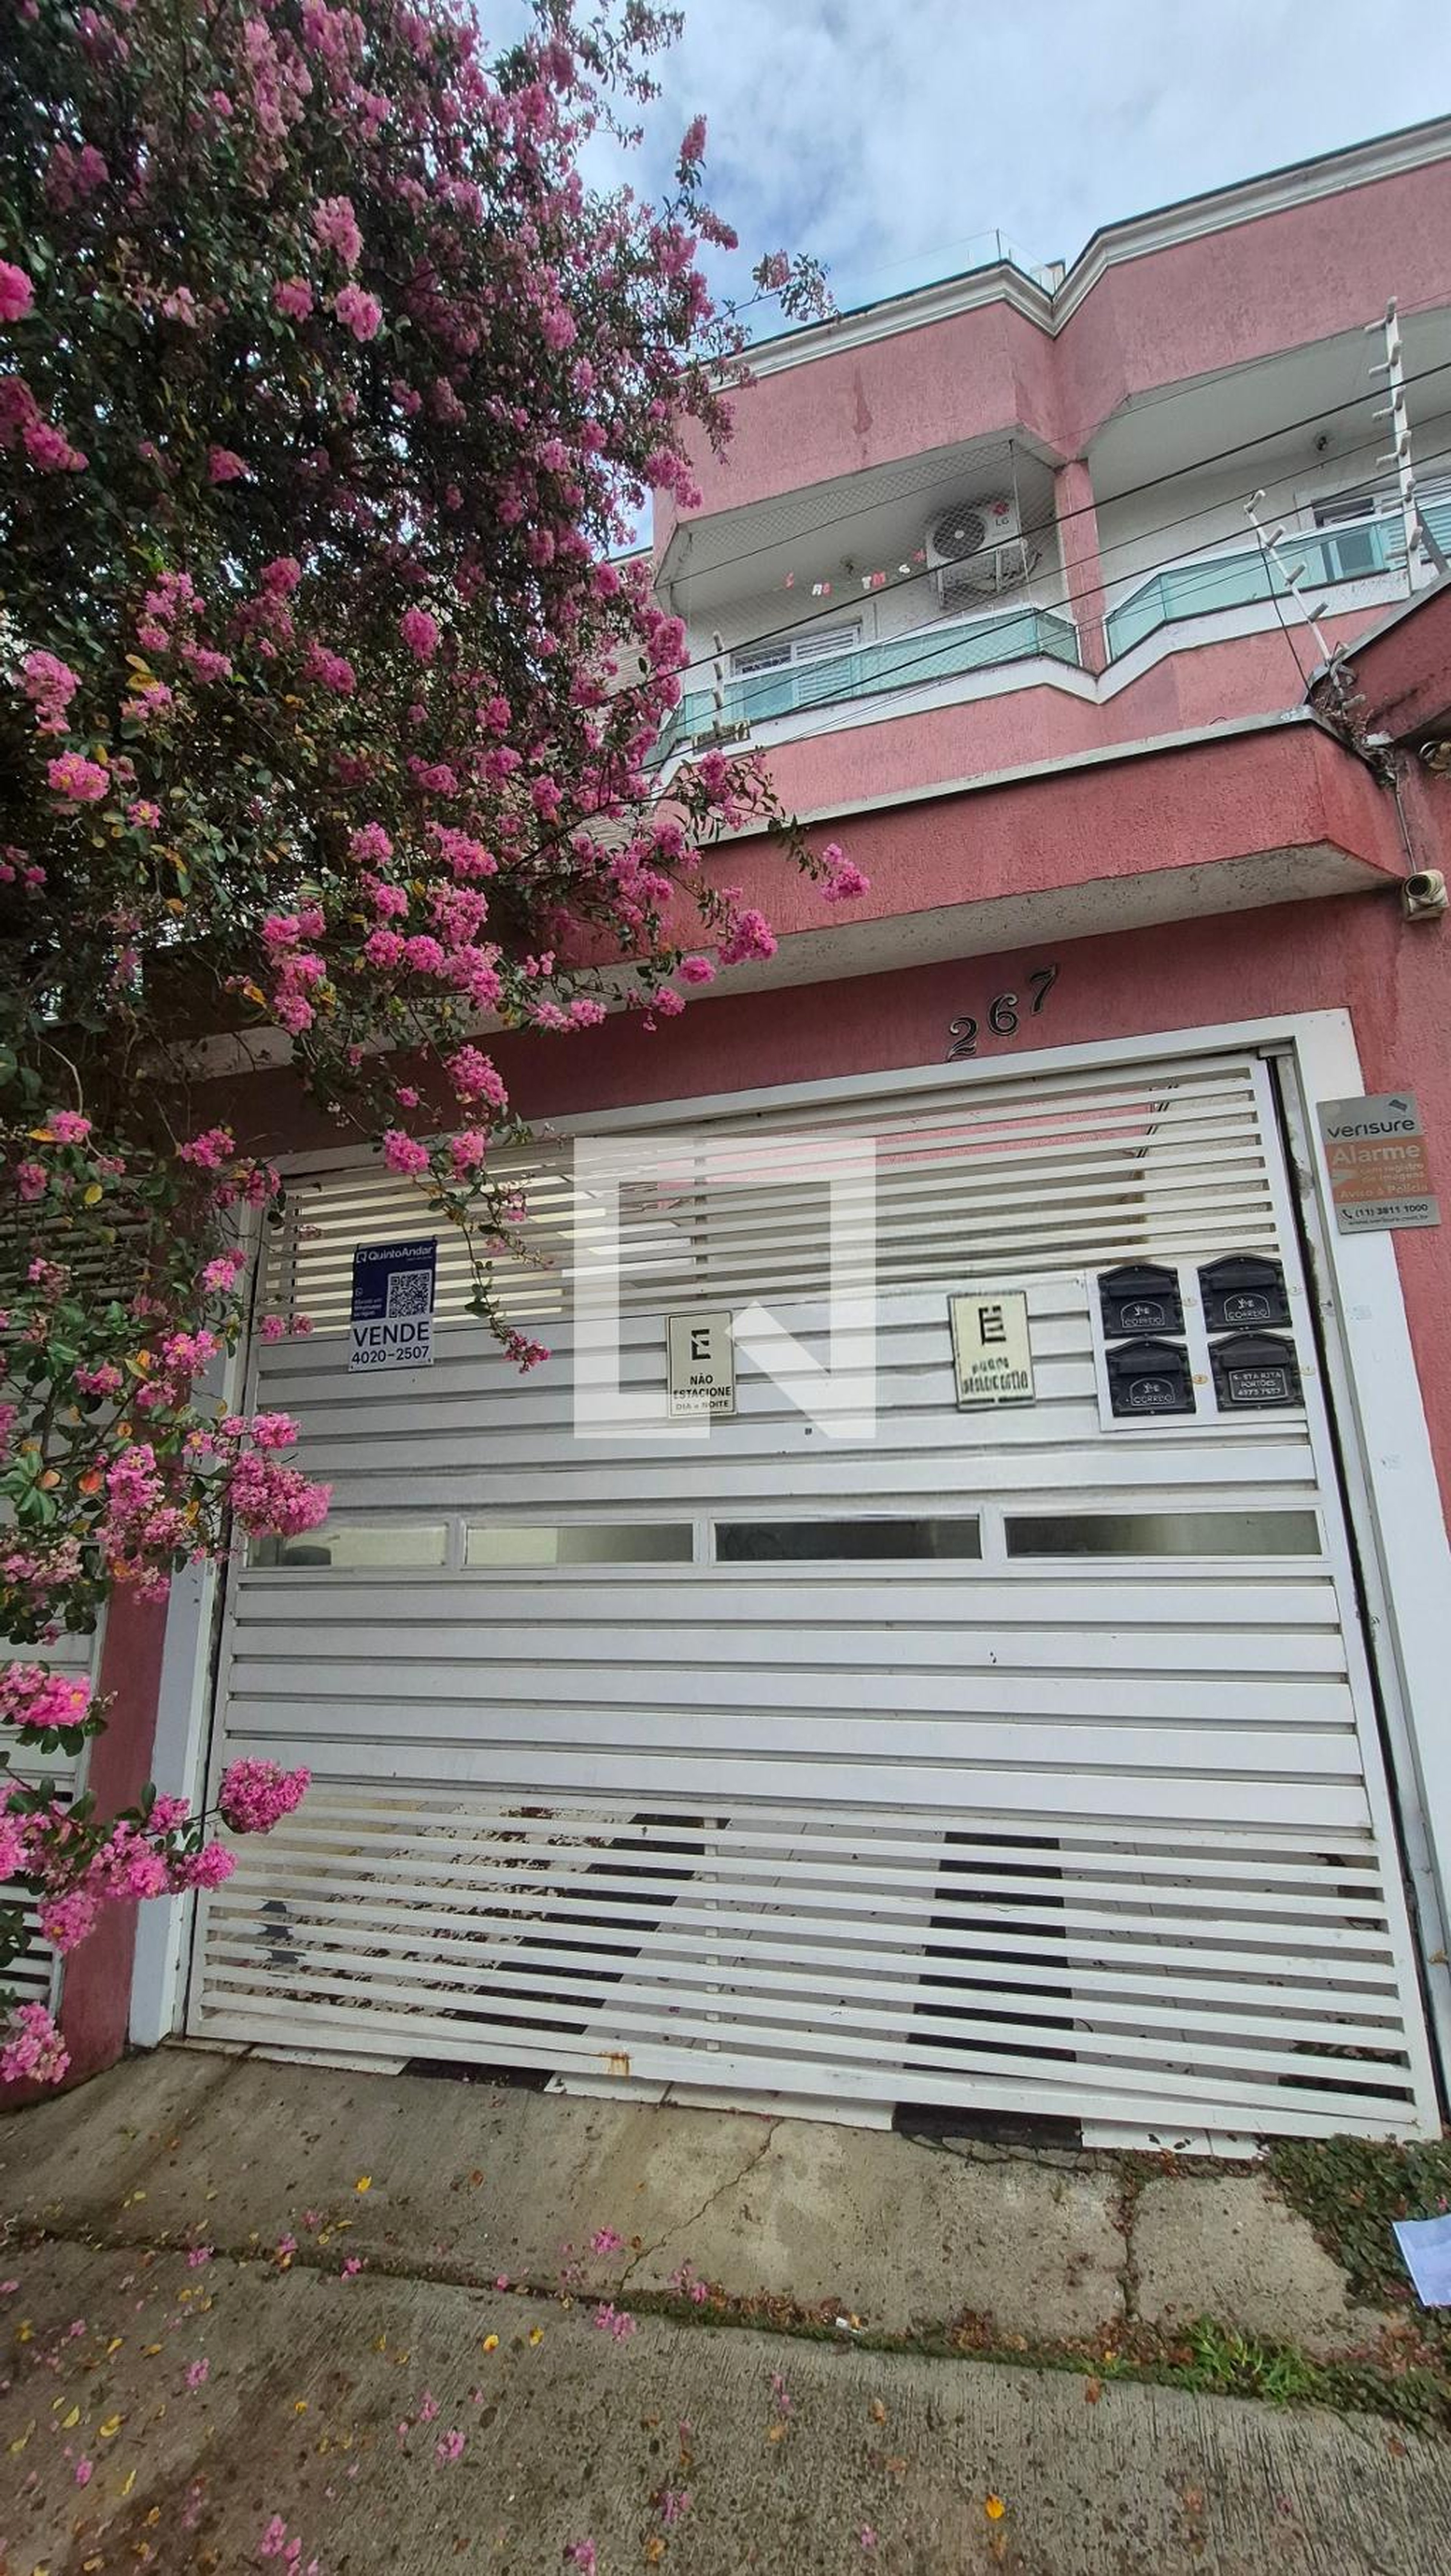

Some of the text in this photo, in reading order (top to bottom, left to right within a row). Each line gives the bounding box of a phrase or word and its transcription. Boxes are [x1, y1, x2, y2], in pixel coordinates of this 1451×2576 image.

[995, 516, 1010, 526] LG
[949, 963, 1057, 1063] 267
[1327, 1119, 1415, 1138] verisure
[1332, 1144, 1421, 1165] Alarme
[1404, 1203, 1428, 1212] 1000
[368, 1246, 433, 1260] QuintoAndar
[353, 1322, 430, 1347] VENDE
[352, 1346, 429, 1364] 4020-2507
[690, 1372, 713, 1385] NÃO
[673, 1385, 732, 1399] ESTACIONE
[702, 1399, 729, 1409] NOITE
